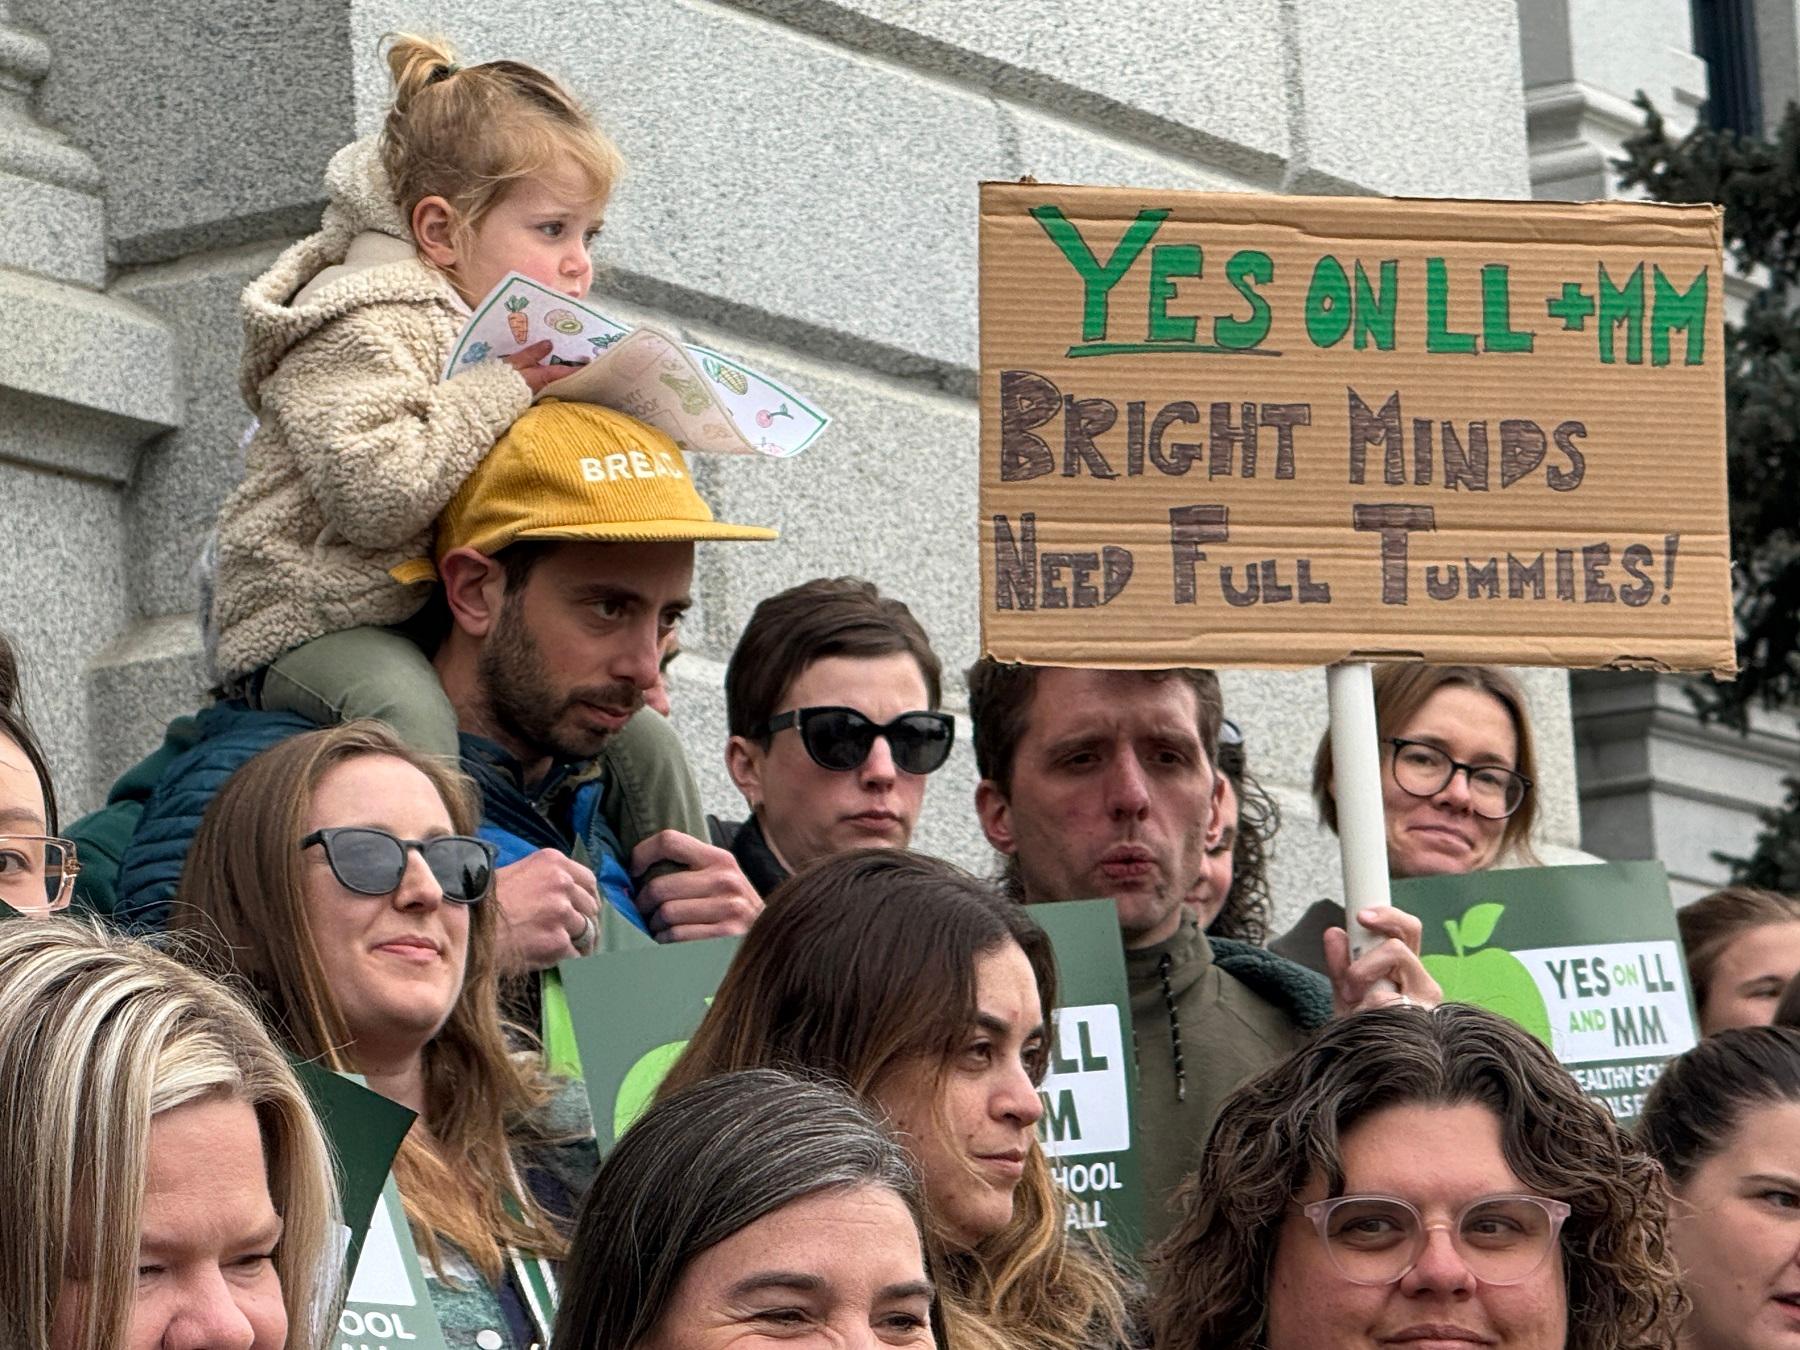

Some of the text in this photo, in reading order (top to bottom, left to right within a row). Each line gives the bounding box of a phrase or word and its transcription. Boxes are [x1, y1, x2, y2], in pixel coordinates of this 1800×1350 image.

[1028, 204, 1274, 350] YES
[1304, 254, 1399, 351] ON
[1426, 257, 1536, 355] LL
[1001, 370, 1588, 492] BRIGHT MINDS
[992, 503, 1680, 611] NEED FULL TUMMIES!
[1544, 953, 1676, 1000] YES ON LL
[1569, 1005, 1668, 1048] AND MM
[1037, 1088, 1082, 1143] M
[1051, 1161, 1123, 1193] HOOL
[338, 1309, 417, 1339] OOL
